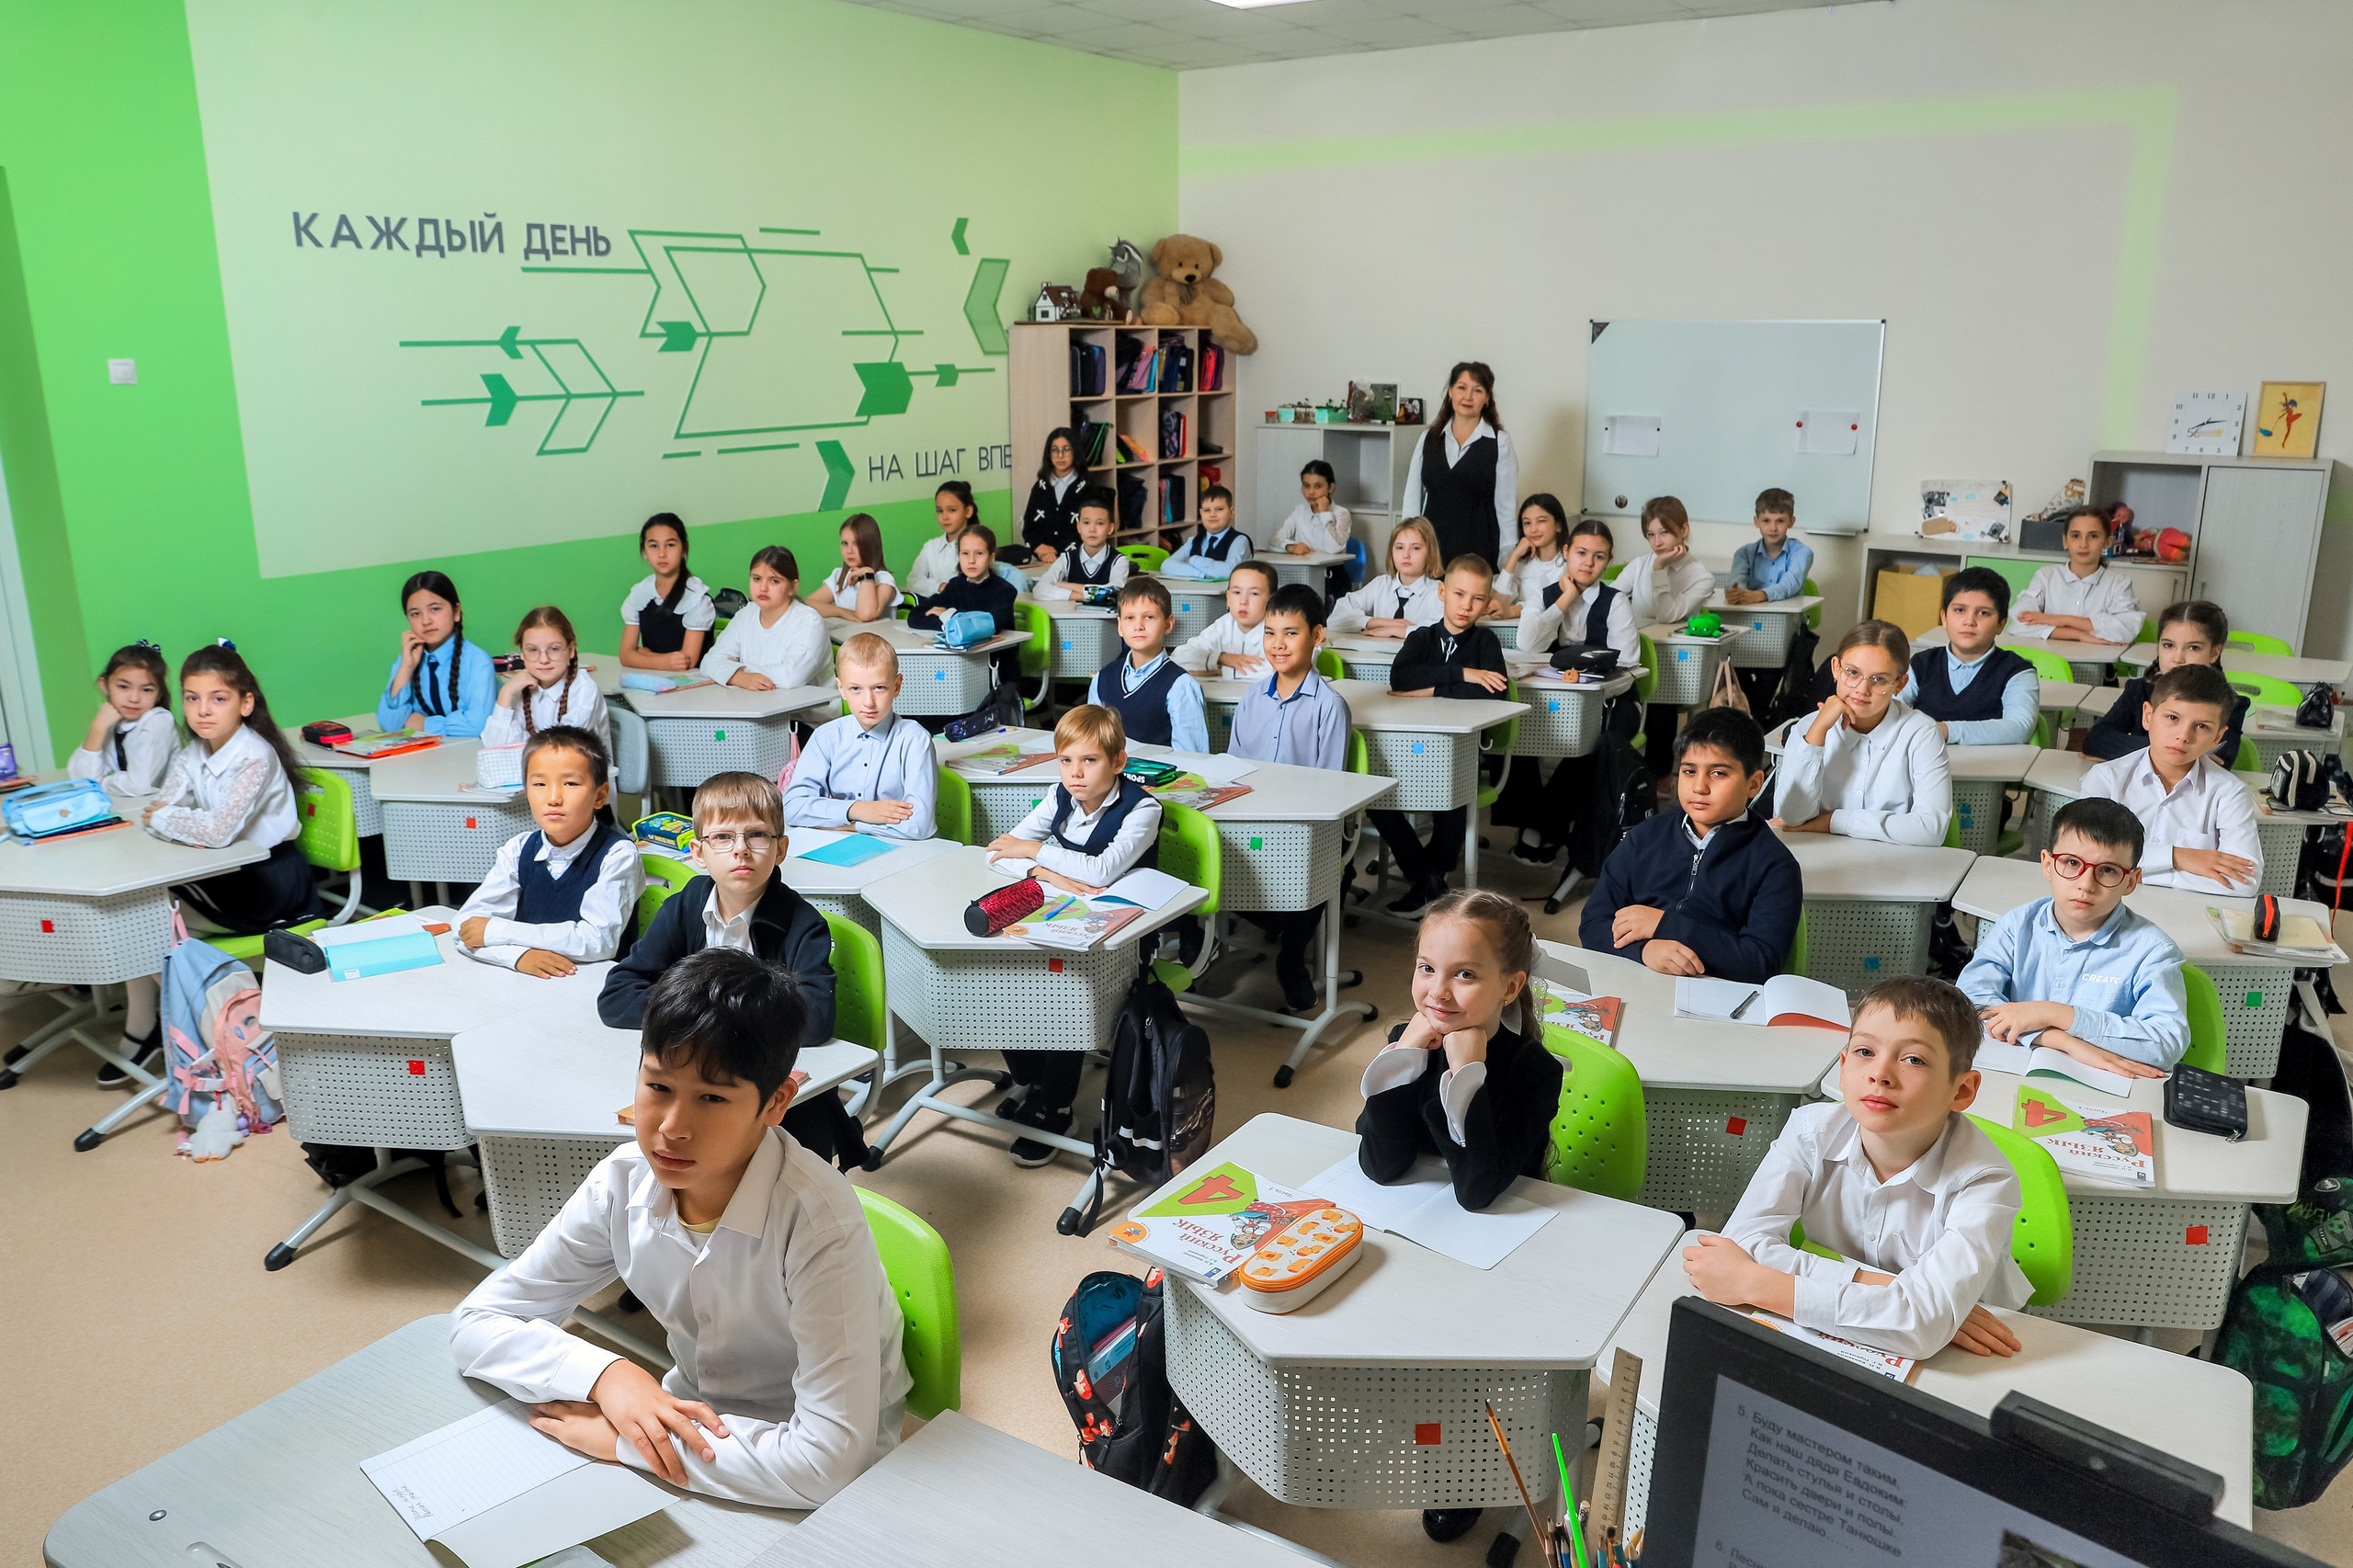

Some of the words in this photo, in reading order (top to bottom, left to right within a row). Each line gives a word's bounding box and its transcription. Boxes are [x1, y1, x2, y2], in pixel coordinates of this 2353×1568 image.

[292, 211, 505, 258] КАЖДЫЙ
[523, 222, 611, 261] ДЕНЬ
[869, 453, 904, 483] НА
[915, 448, 966, 477] ШАГ
[2021, 1098, 2067, 1128] 4
[2069, 1149, 2146, 1169] Русский
[1177, 1174, 1245, 1206] 4
[1178, 1233, 1245, 1264] Русский
[1737, 1404, 1748, 1418] 5.
[1752, 1411, 1783, 1436] Буду
[1787, 1430, 1852, 1467] мастером
[1750, 1426, 1772, 1446] Как
[1776, 1441, 1803, 1460] наш
[1805, 1454, 1840, 1477] дядя
[1746, 1458, 1798, 1491] Красить
[1801, 1485, 1842, 1512] двери
[1845, 1506, 1854, 1517] и
[1747, 1443, 1794, 1471] Делать
[1797, 1466, 1842, 1494] стулья
[1846, 1489, 1855, 1500] и
[1742, 1488, 1769, 1510] Сам
[1772, 1505, 1780, 1515] я
[1744, 1473, 1753, 1485] А
[1756, 1482, 1786, 1502] пока
[1789, 1496, 1835, 1525] сестре
[1839, 1518, 1902, 1558] Танюшке
[1715, 1540, 1726, 1553] 6.
